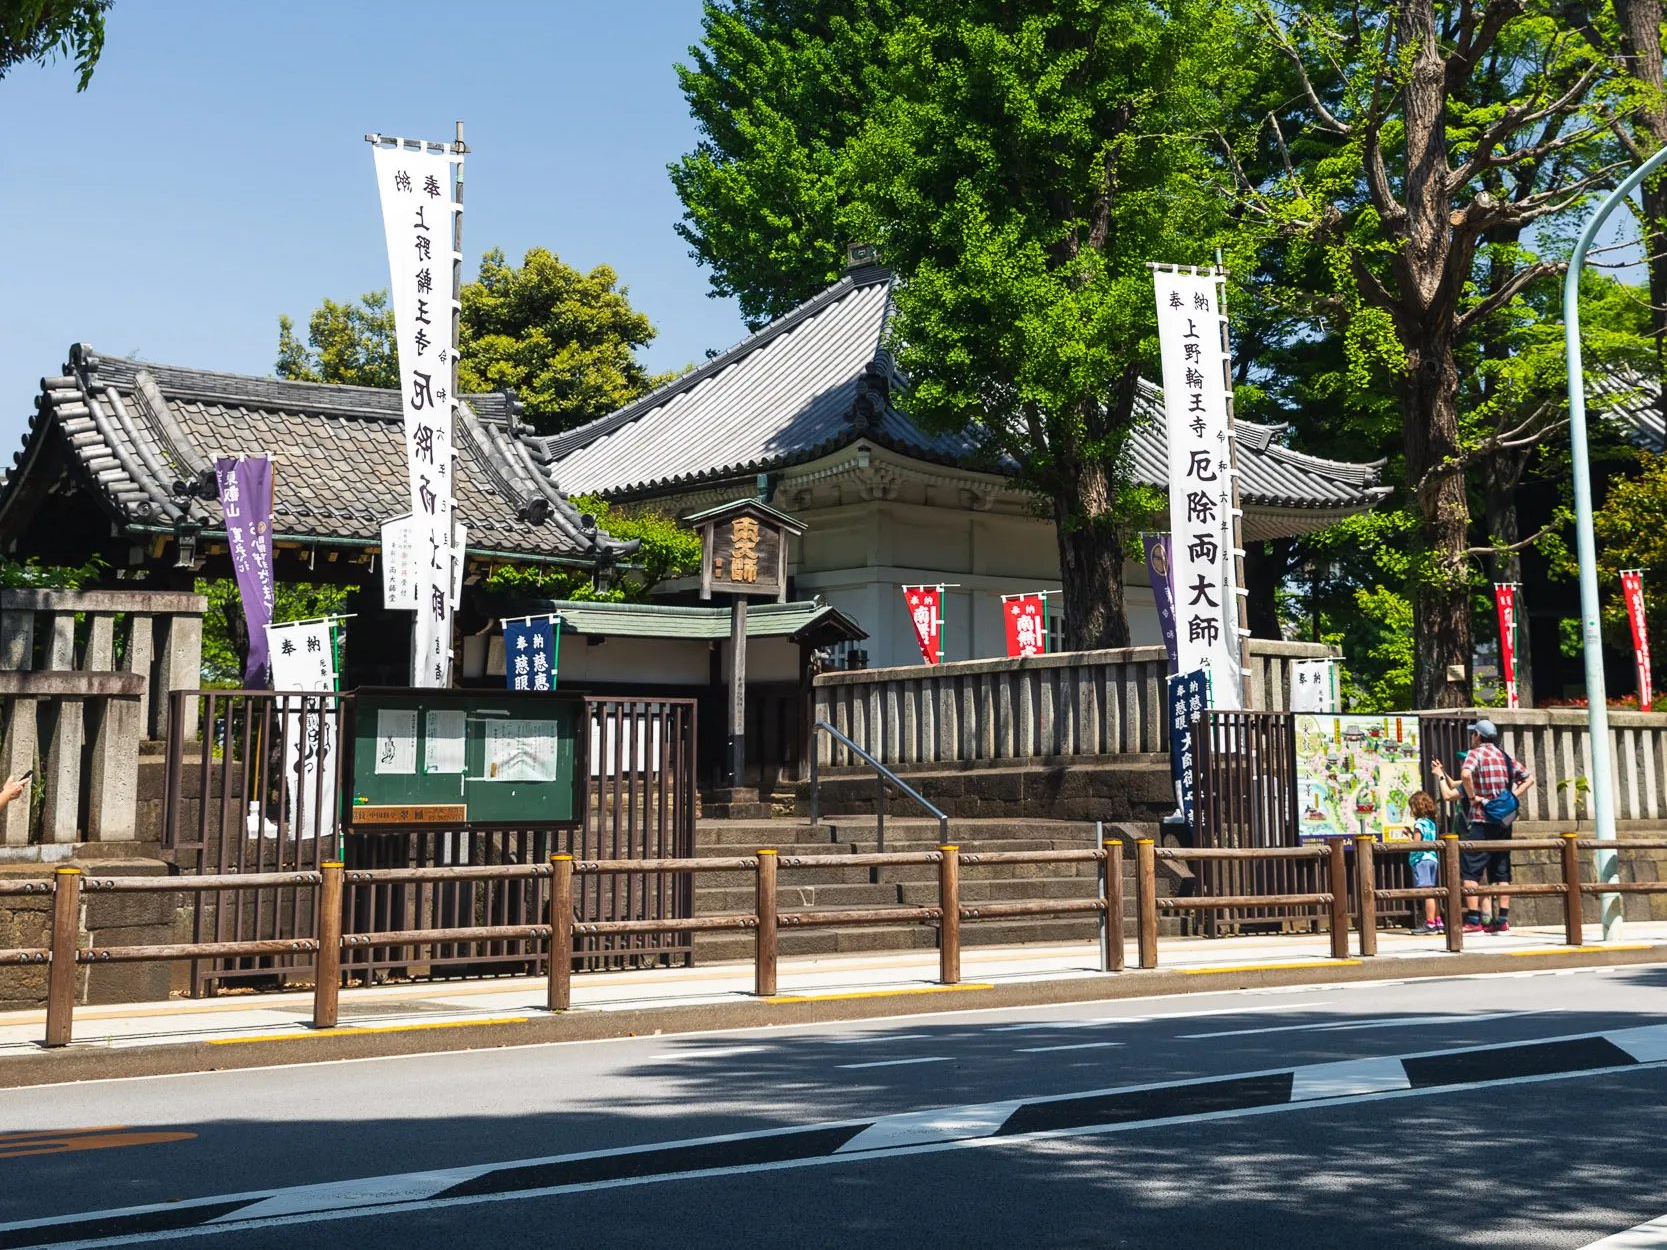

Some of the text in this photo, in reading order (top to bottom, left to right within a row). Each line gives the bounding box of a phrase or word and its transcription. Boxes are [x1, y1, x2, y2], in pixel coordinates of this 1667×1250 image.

[1169, 290, 1209, 312] 奉納
[1182, 318, 1207, 439] 上野輪王寺
[1186, 449, 1220, 647] 厄除両大師
[281, 636, 321, 656] 奉納
[516, 633, 544, 651] 奉納
